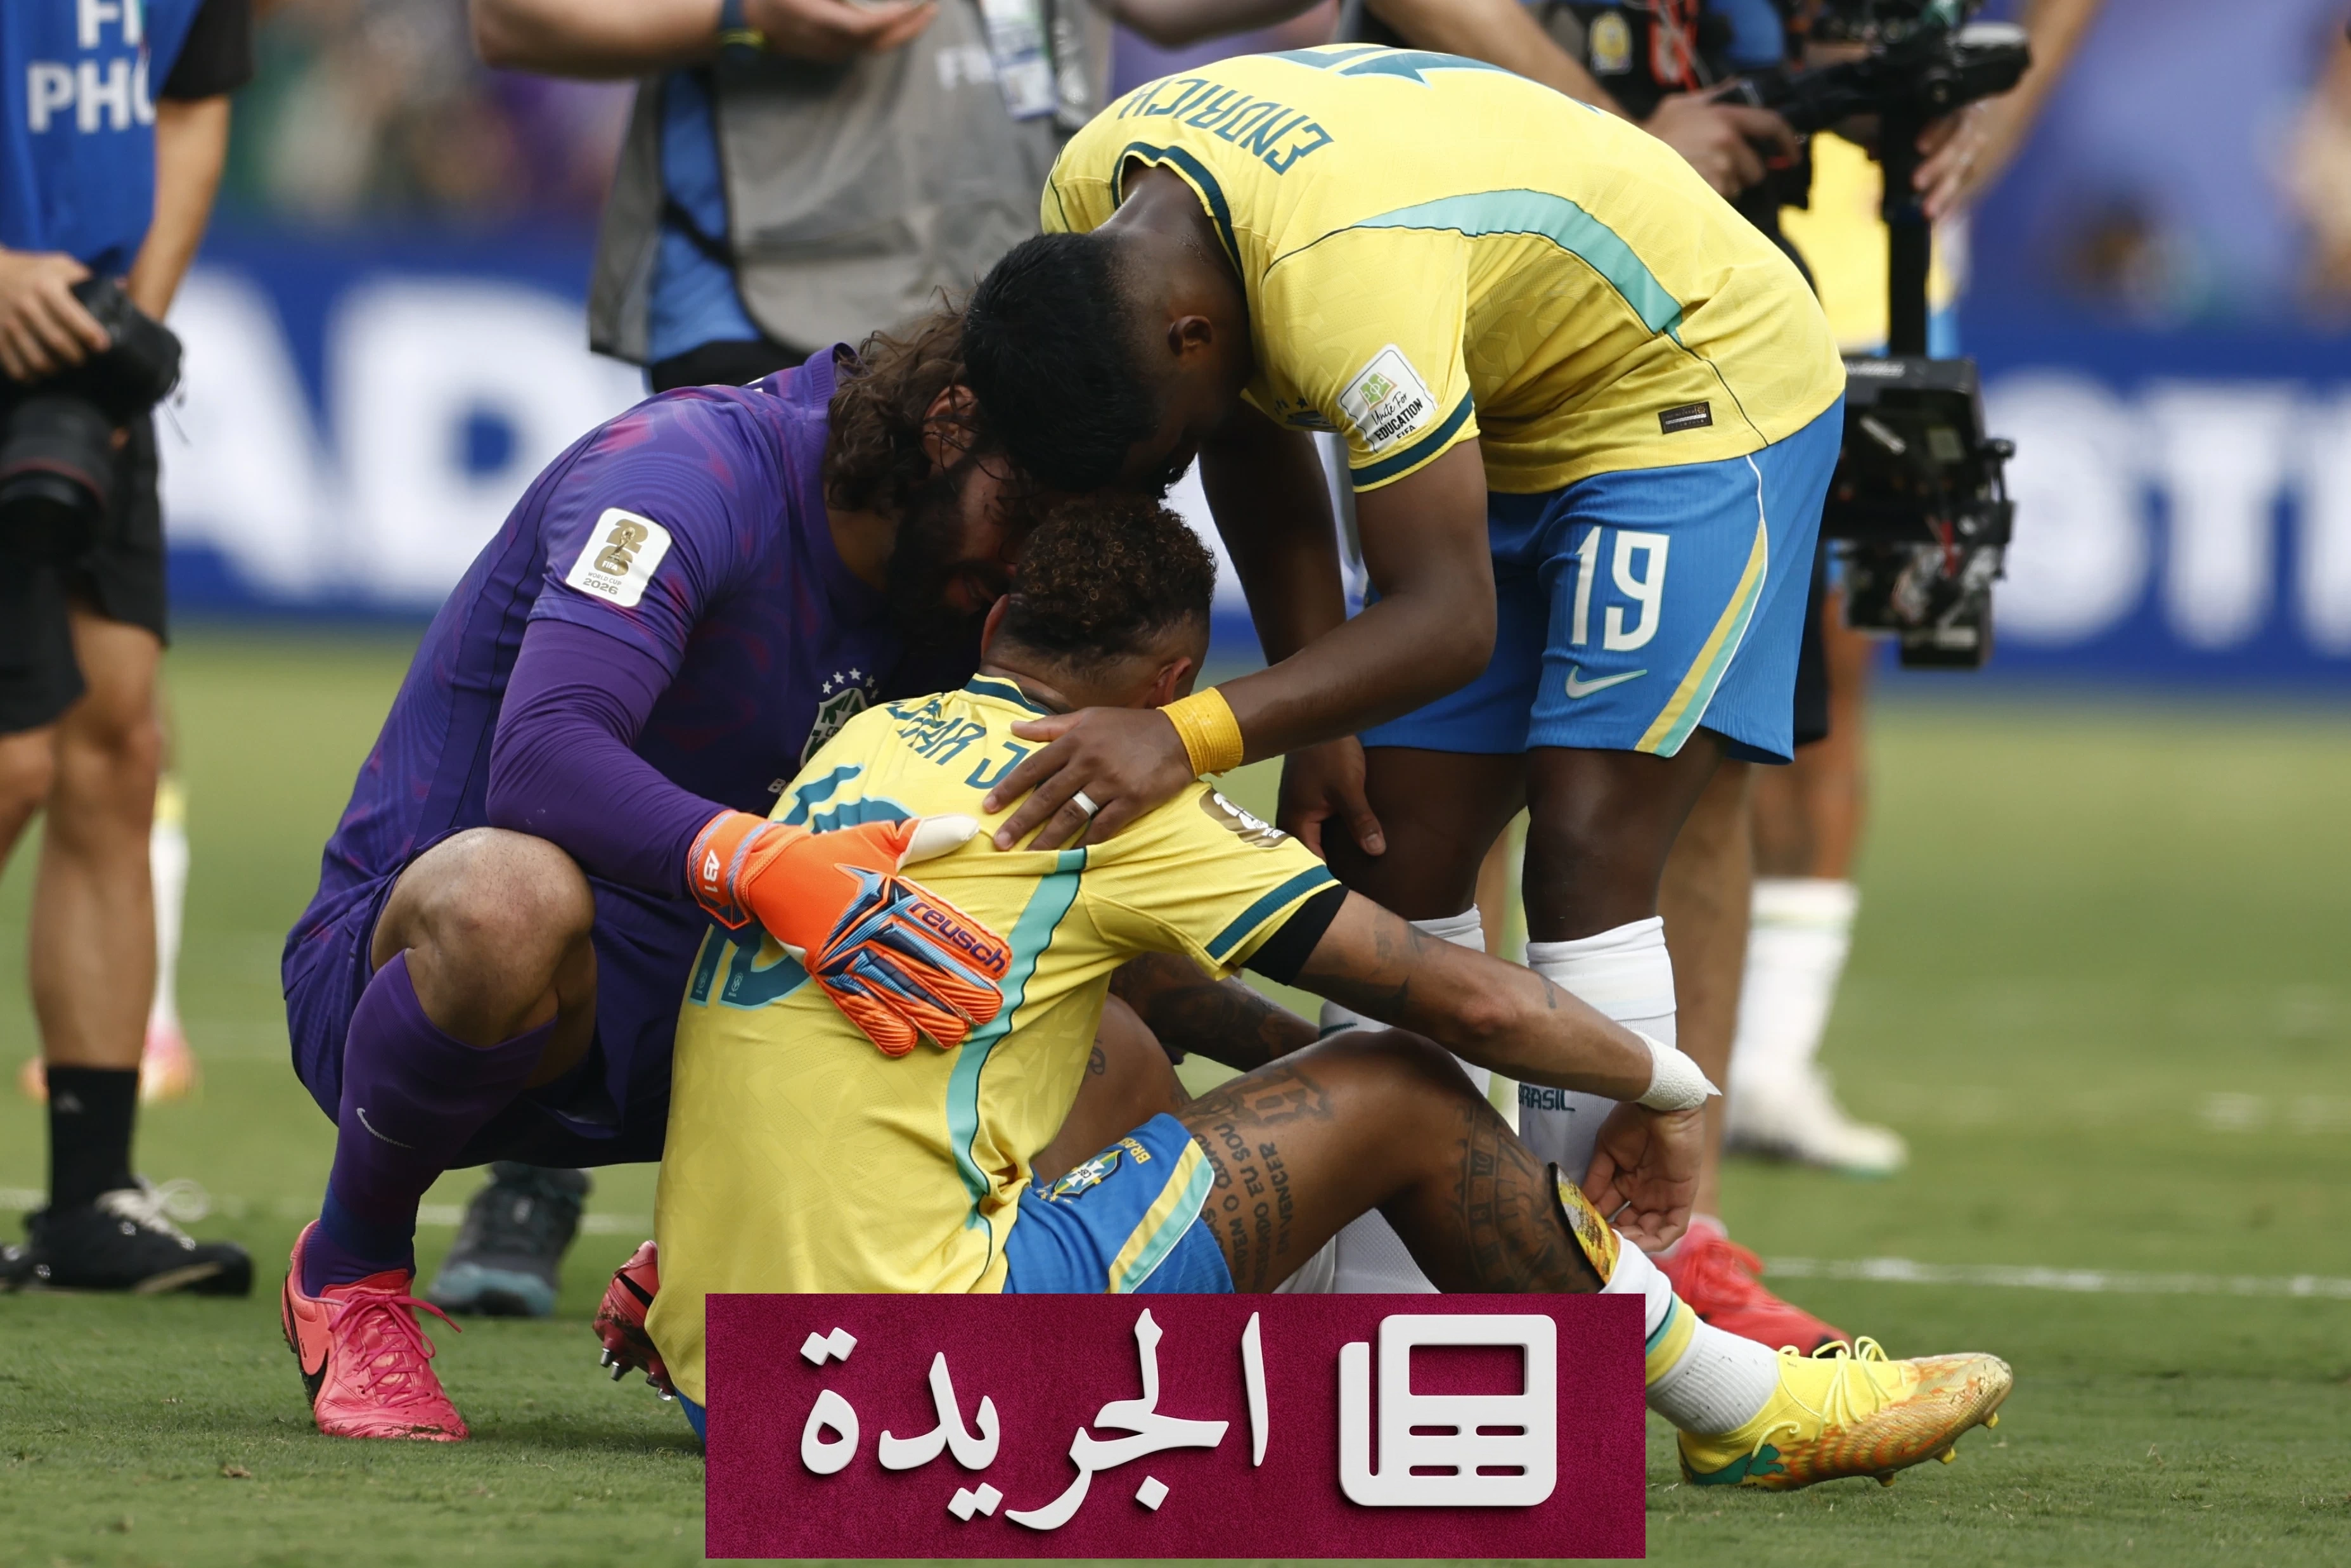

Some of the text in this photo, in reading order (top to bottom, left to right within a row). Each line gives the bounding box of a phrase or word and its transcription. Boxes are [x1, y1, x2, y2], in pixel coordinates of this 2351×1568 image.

[1392, 390, 1408, 408] For
[1374, 397, 1423, 441] EDUCATION
[1396, 424, 1416, 439] FIFA
[588, 571, 622, 586] WORLD CUP
[602, 560, 618, 571] FIFA
[583, 577, 619, 595] 2026
[1571, 525, 1670, 652] 19
[909, 900, 1005, 973] reusch
[1213, 1122, 1251, 1162] SOU
[1259, 1141, 1294, 1228] VENCER
